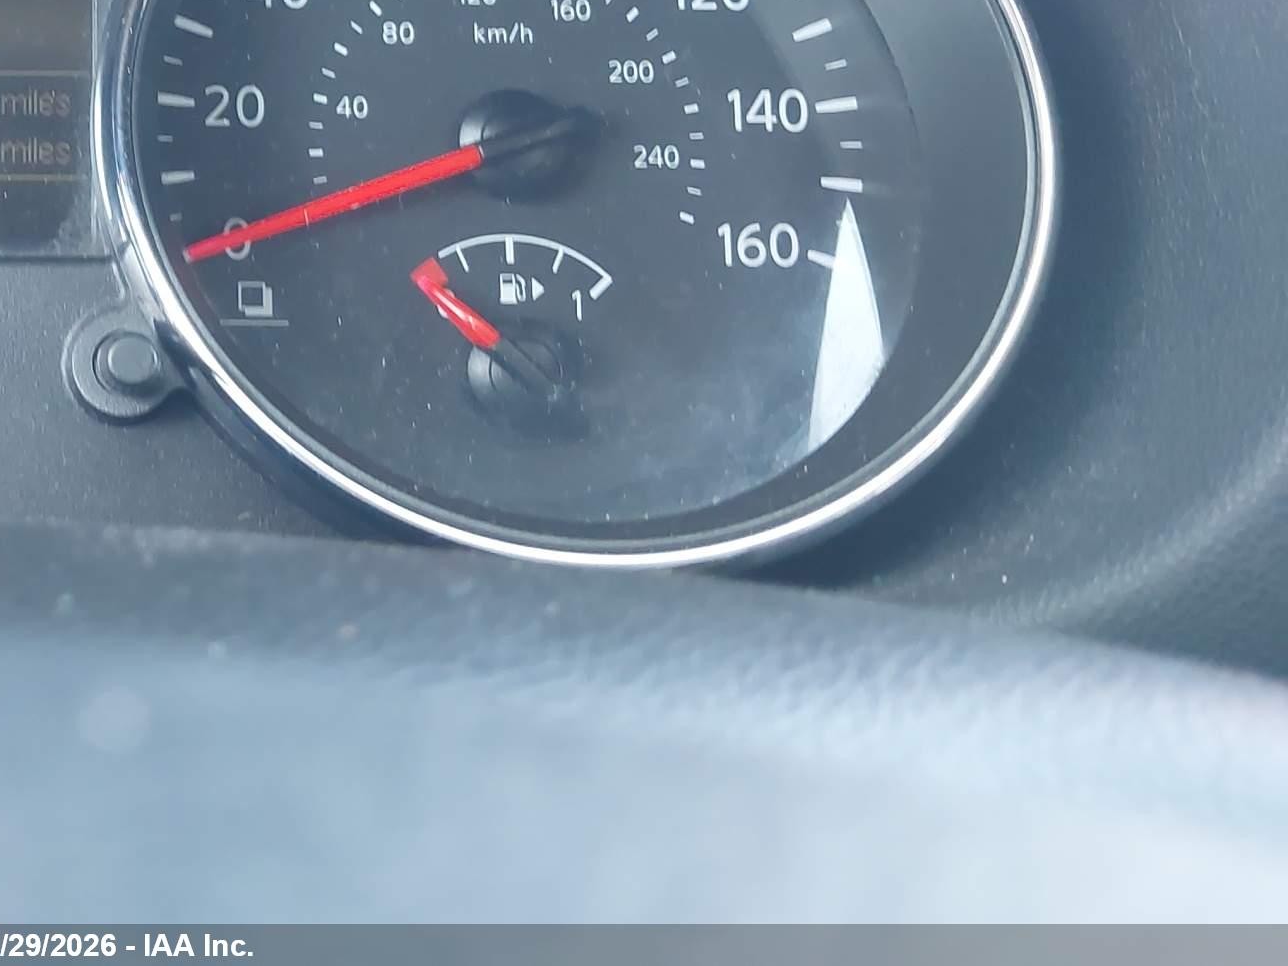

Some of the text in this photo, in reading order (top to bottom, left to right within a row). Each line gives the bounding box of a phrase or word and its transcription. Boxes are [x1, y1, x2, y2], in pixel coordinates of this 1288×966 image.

[382, 21, 415, 45] 80
[473, 22, 533, 45] km/h
[608, 60, 654, 84] 200
[1, 87, 71, 117] miles
[205, 85, 265, 127] 20
[336, 95, 368, 119] 40
[727, 88, 809, 133] 140
[1, 136, 71, 165] miles
[634, 145, 680, 169] 240
[717, 222, 799, 268] 160
[571, 289, 582, 321] 1
